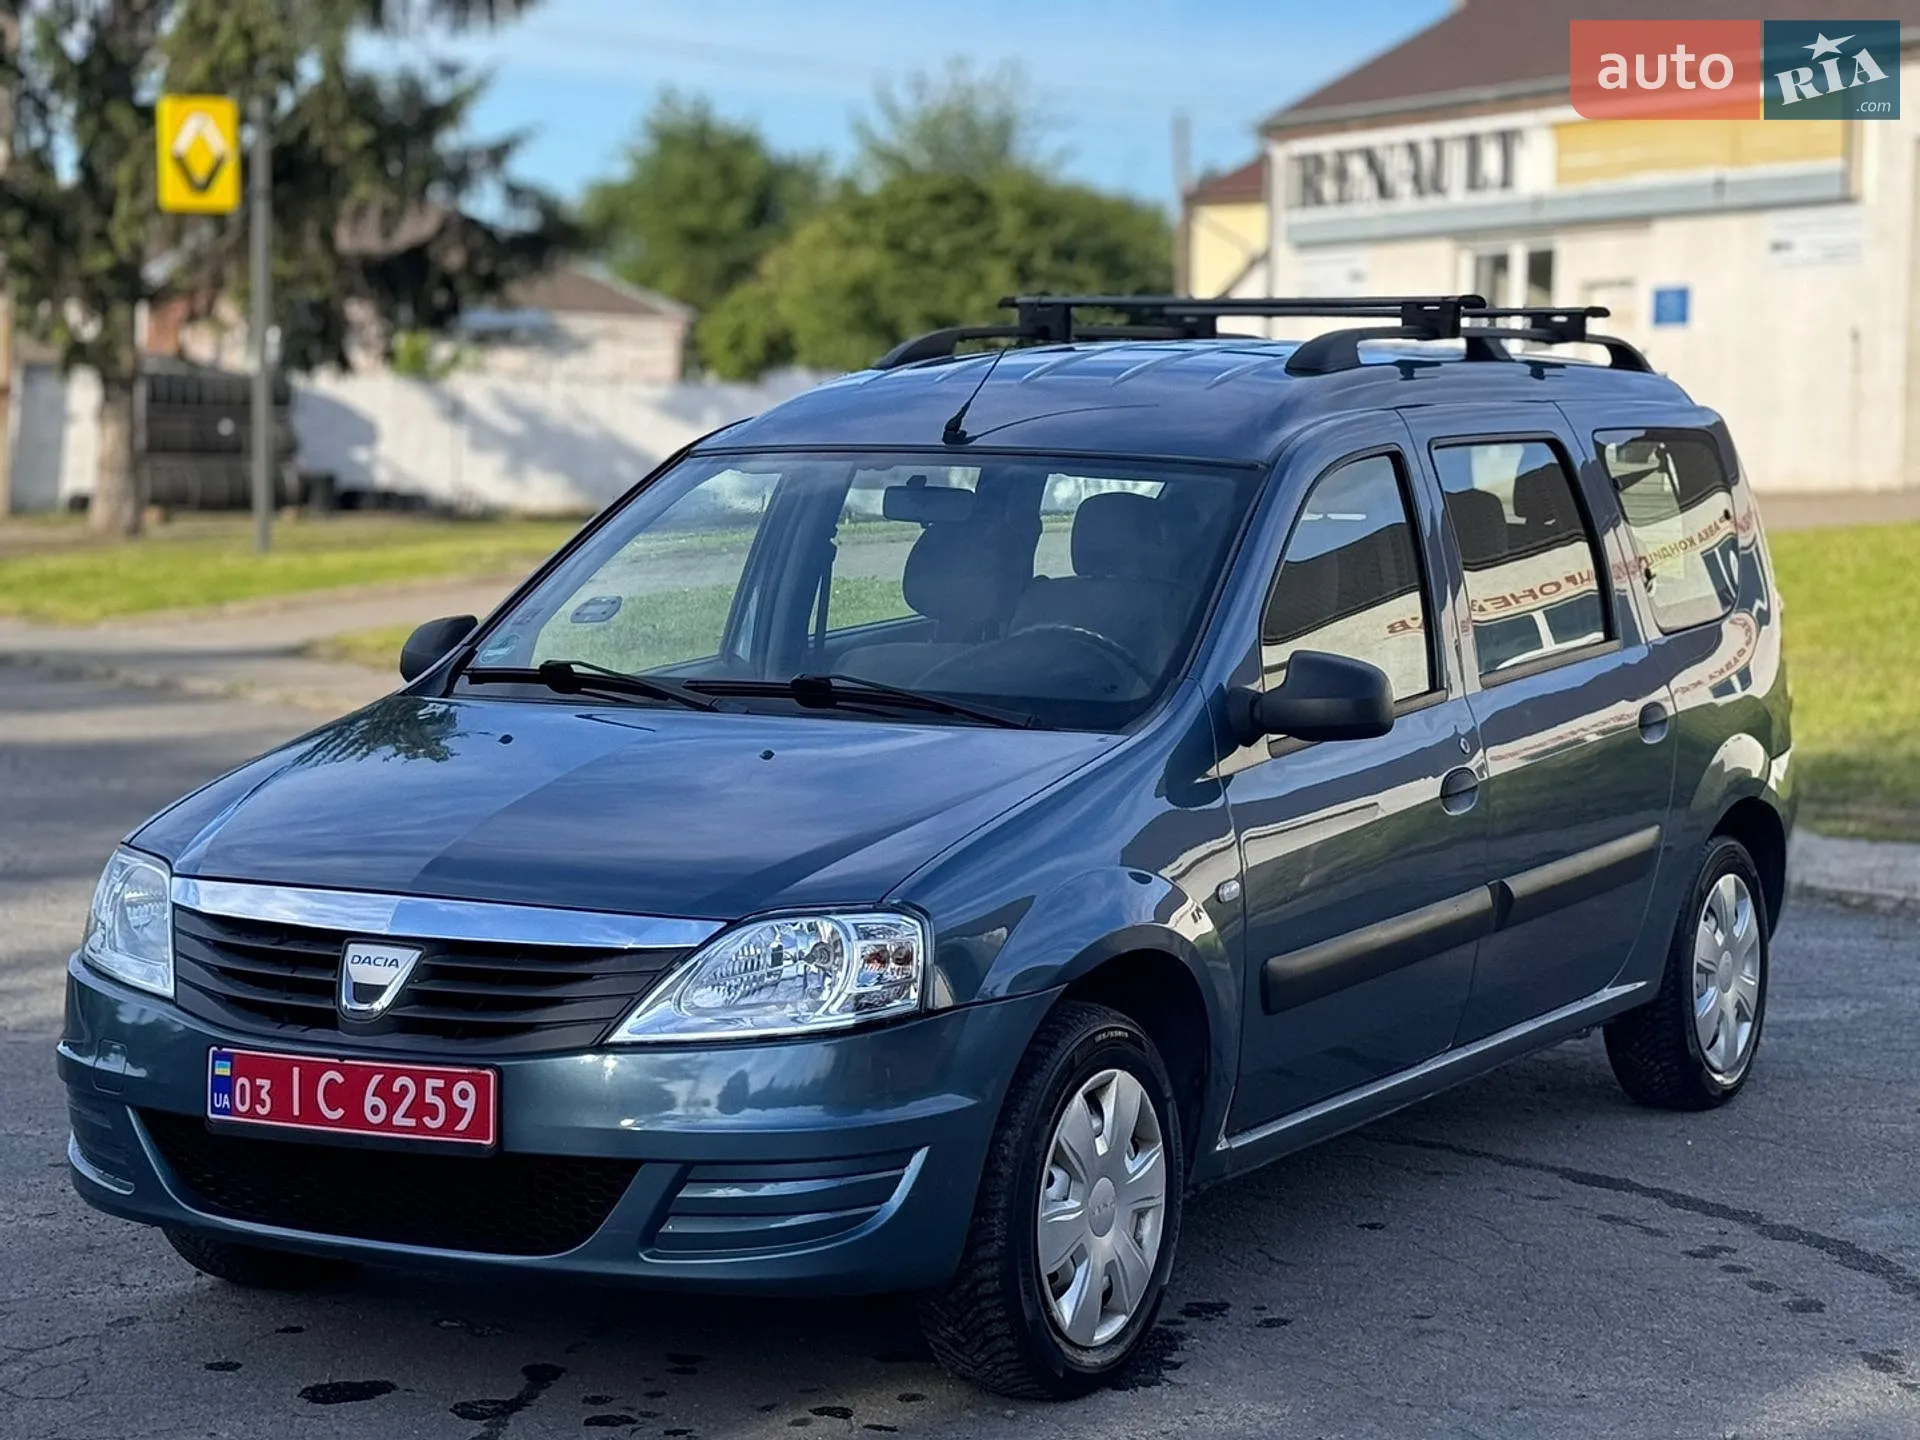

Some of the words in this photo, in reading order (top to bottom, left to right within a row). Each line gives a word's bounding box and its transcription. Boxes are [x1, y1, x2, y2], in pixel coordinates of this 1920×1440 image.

[1293, 128, 1524, 207] RENAULT
[350, 954, 400, 969] DACIA
[213, 1091, 231, 1109] UA
[234, 1076, 272, 1116] 03
[363, 1073, 477, 1132] 6259
